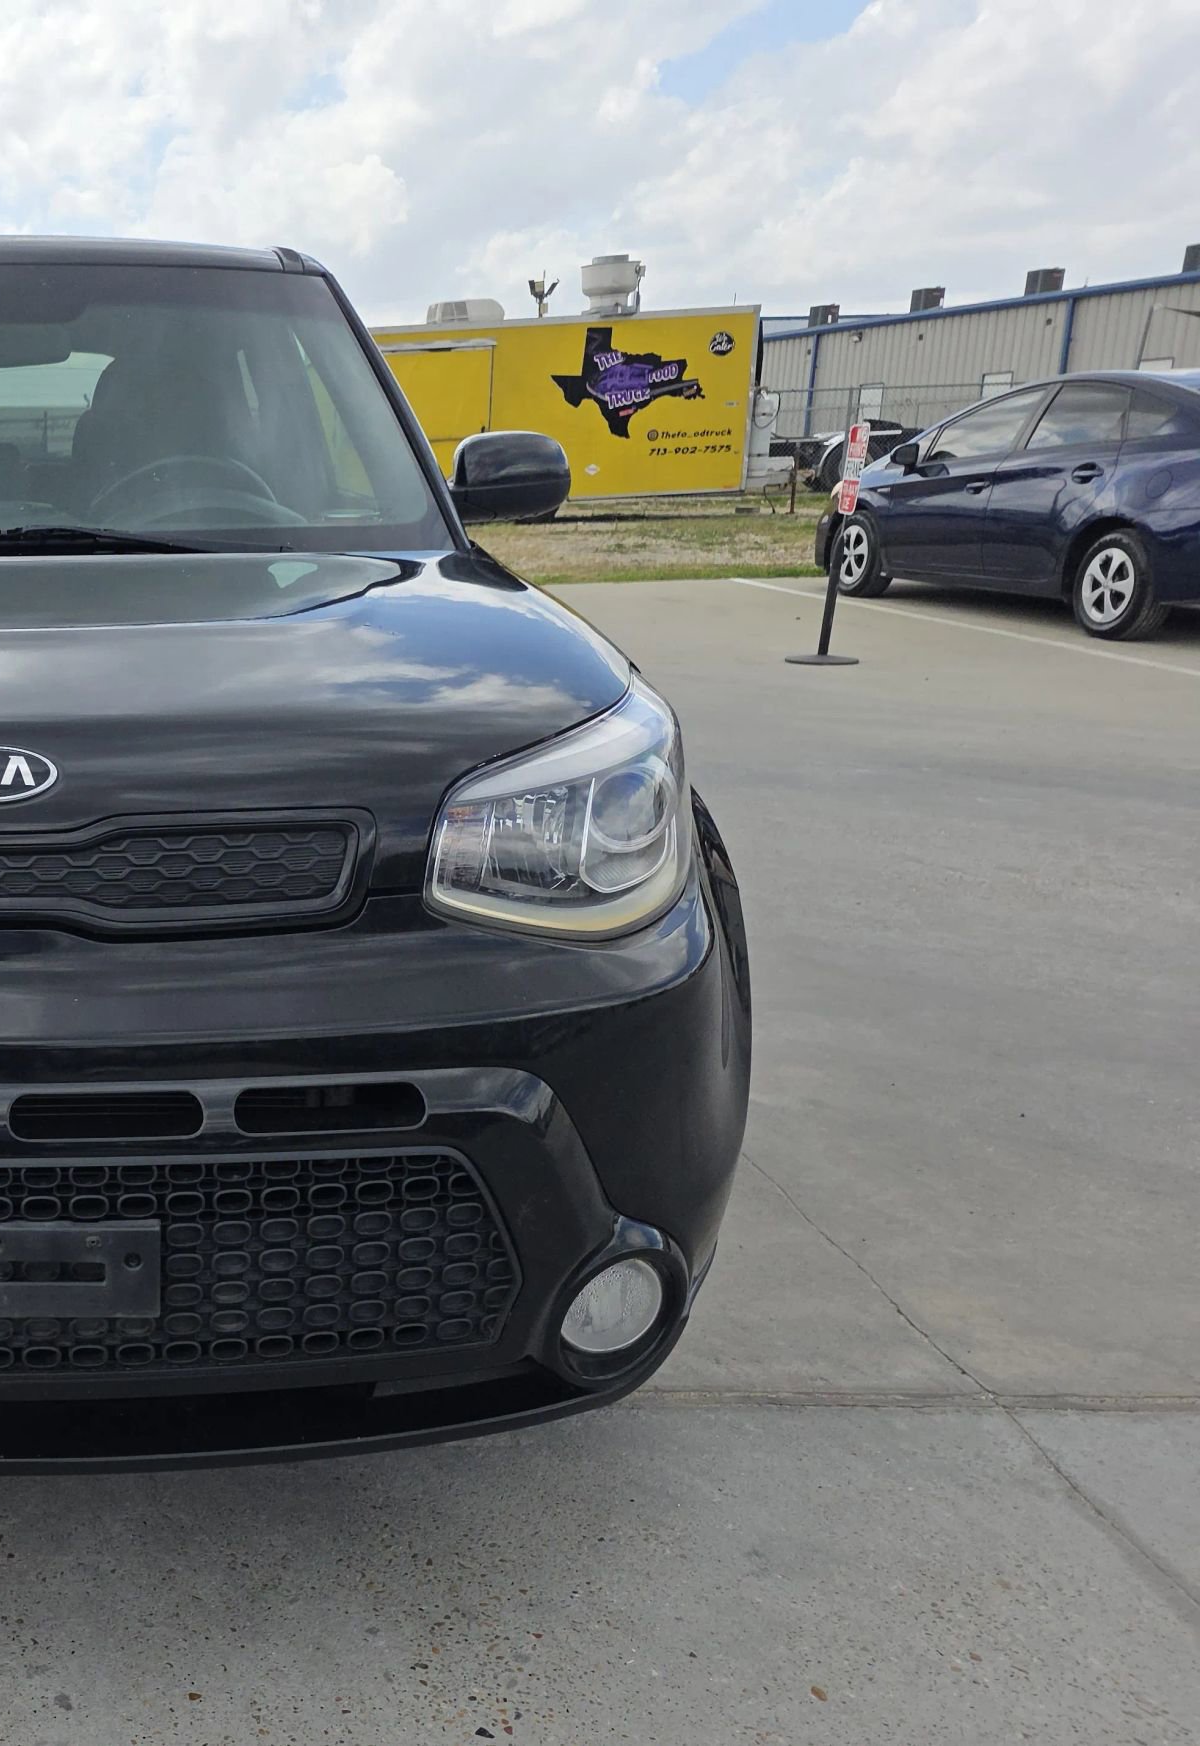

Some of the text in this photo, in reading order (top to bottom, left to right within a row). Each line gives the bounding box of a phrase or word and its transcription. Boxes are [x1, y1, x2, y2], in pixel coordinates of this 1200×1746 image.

[594, 352, 624, 371] THE
[605, 388, 651, 409] TRUCK
[649, 444, 732, 456] 713-902-7575
